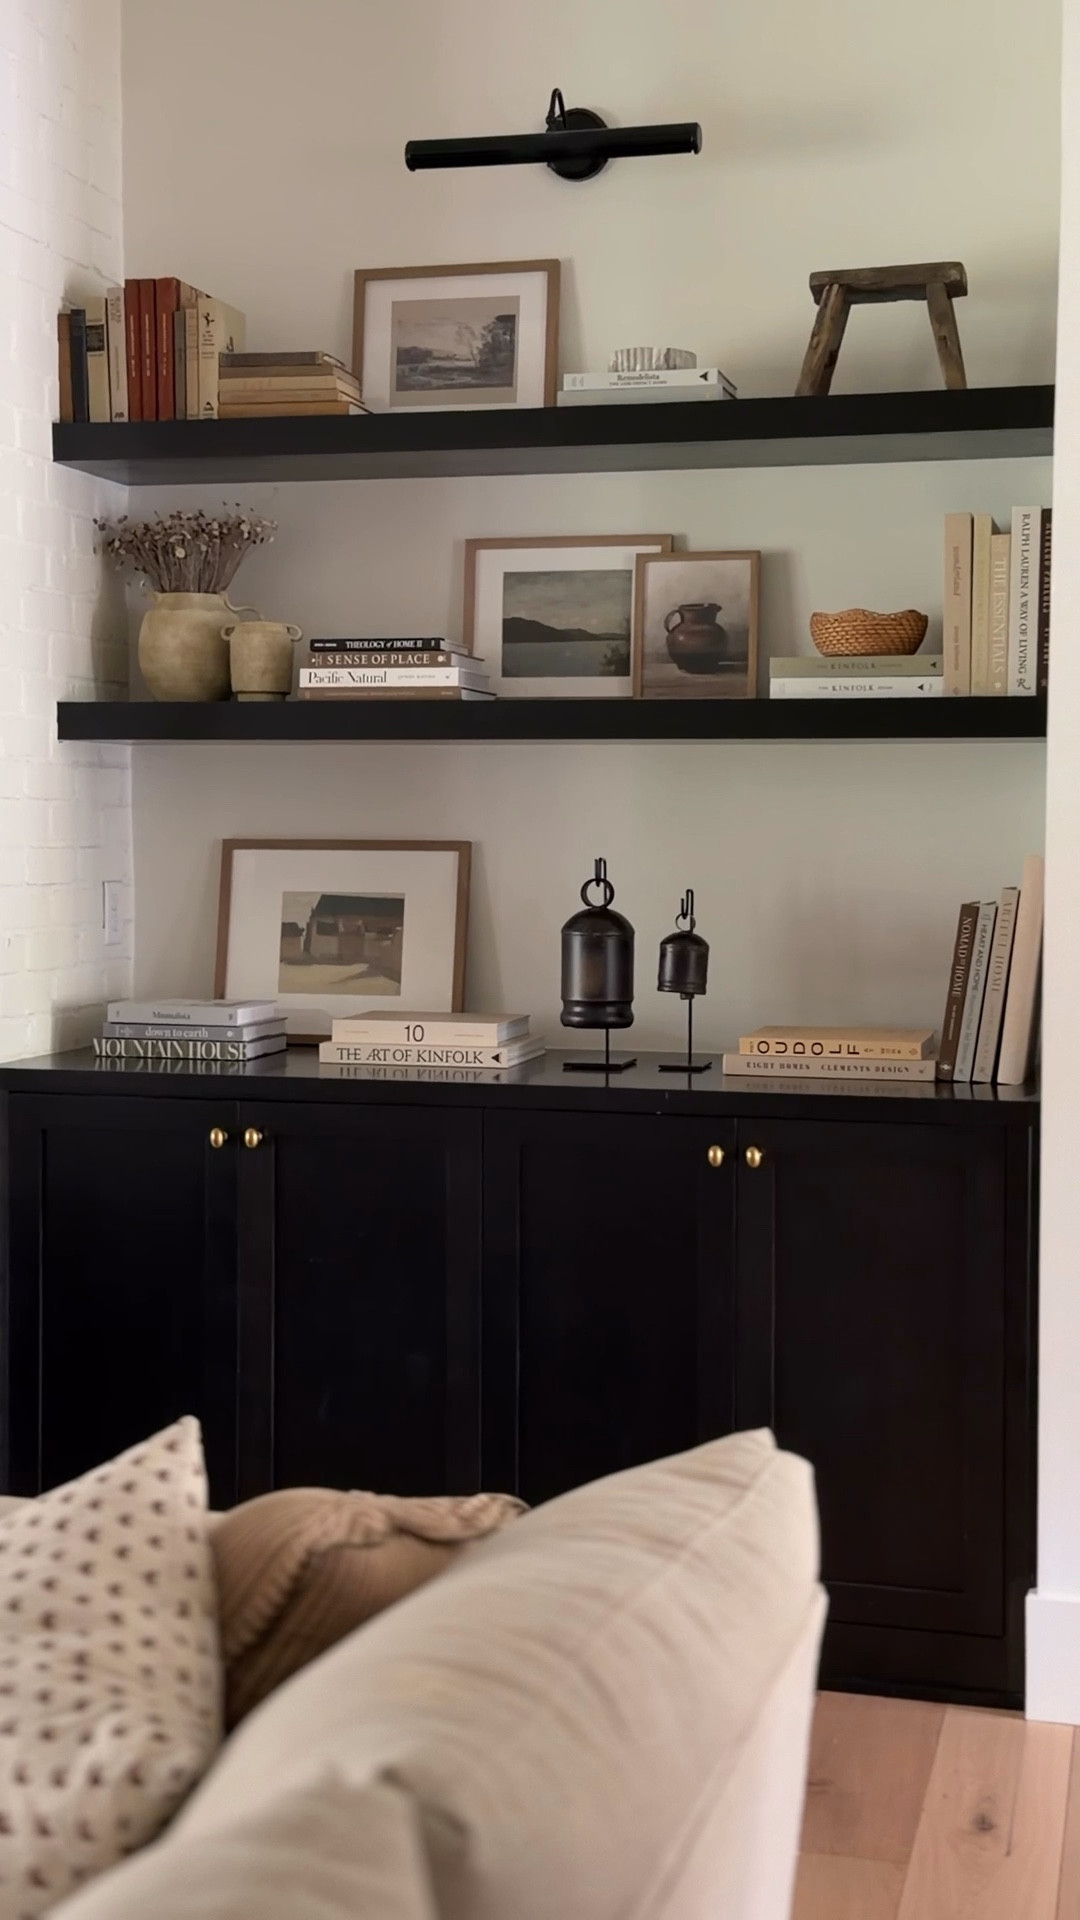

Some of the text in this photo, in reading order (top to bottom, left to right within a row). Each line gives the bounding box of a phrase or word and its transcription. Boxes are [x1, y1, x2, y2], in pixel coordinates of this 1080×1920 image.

[993, 558, 1007, 587] THE
[1018, 513, 1031, 674] RALPH LAUREN A WAY OF LIVING
[992, 591, 1006, 674] ESSENTIALS
[345, 640, 386, 649] THEOLOGY
[393, 640, 415, 648] HOME
[326, 654, 369, 665] SENSE
[371, 654, 387, 664] OF
[390, 653, 430, 664] PLACE
[308, 671, 344, 684] Pacific
[347, 671, 387, 684] Natural
[831, 684, 874, 692] KINFOLK
[957, 915, 972, 958] NOMAD
[976, 949, 985, 968] AND
[951, 965, 965, 997] HOME
[145, 1027, 209, 1038] down to earth
[404, 1024, 425, 1042] 10
[93, 1038, 247, 1060] MOUNTAIN HOUSE
[336, 1047, 483, 1064] THE ART OF KINFOLK
[757, 1040, 860, 1056] OUDOLF
[779, 1062, 810, 1070] HOMES
[821, 1064, 871, 1072] CLEMENTS
[874, 1065, 910, 1073] DESIGN
